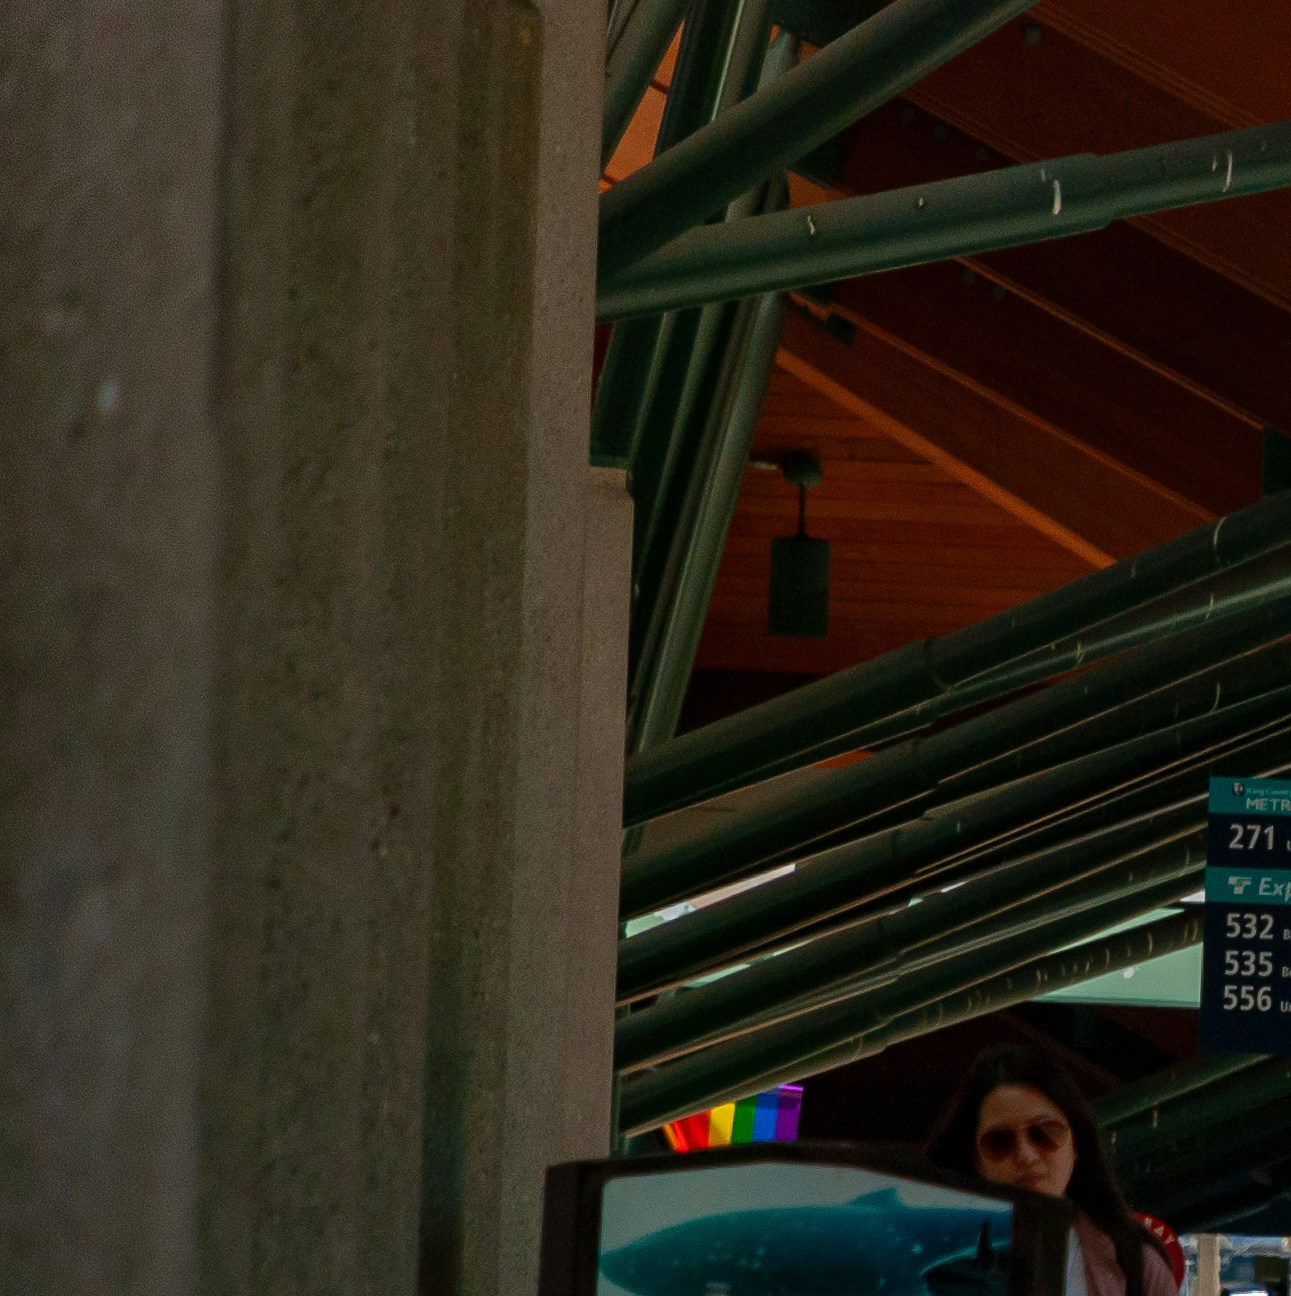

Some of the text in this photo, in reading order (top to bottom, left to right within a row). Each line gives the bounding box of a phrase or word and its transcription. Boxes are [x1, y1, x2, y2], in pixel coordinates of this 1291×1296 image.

[1229, 823, 1274, 849] 271
[1226, 913, 1274, 940] 532
[1224, 950, 1273, 977] 535
[1223, 985, 1272, 1012] 556
